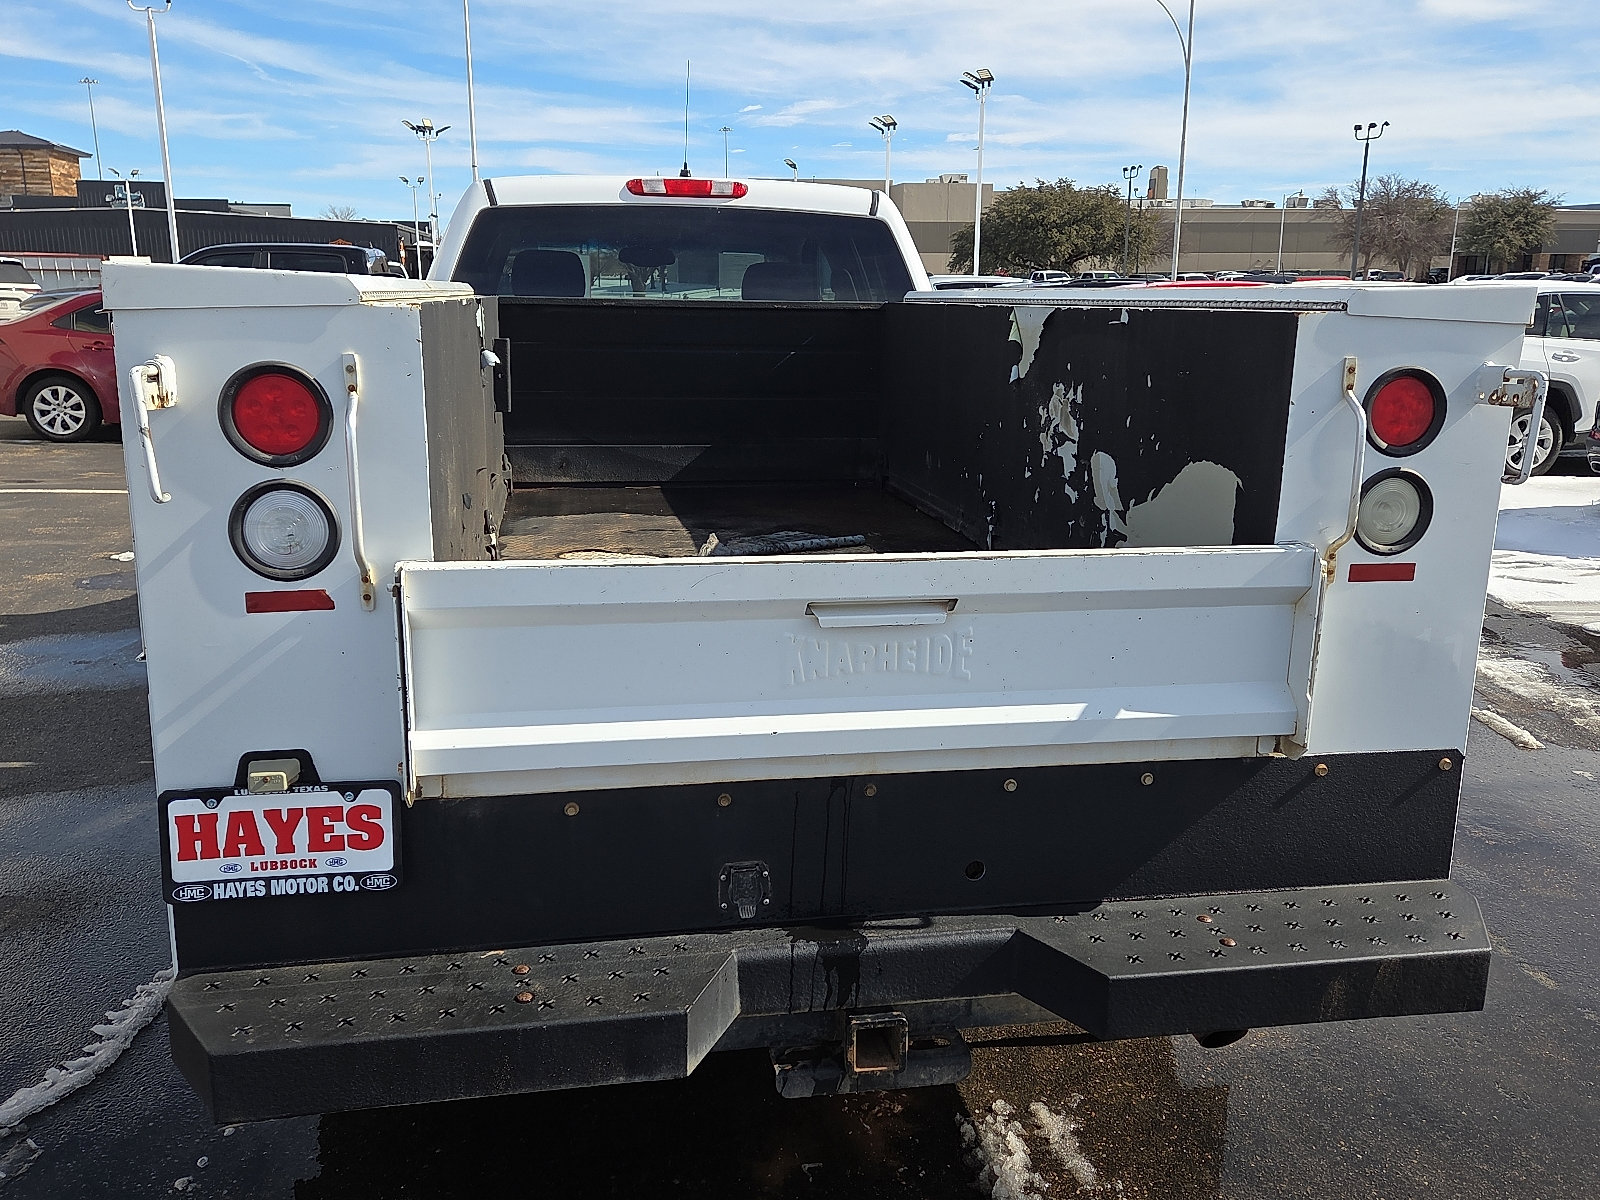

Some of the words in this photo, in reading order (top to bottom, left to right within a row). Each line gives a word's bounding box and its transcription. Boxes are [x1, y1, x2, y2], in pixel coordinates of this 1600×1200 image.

[292, 785, 329, 793] TEXAS
[174, 804, 385, 862] HAYES
[250, 858, 318, 872] LUBBOCK
[213, 880, 266, 900] HAYES
[270, 876, 329, 896] MOTOR
[332, 875, 360, 893] CO.
